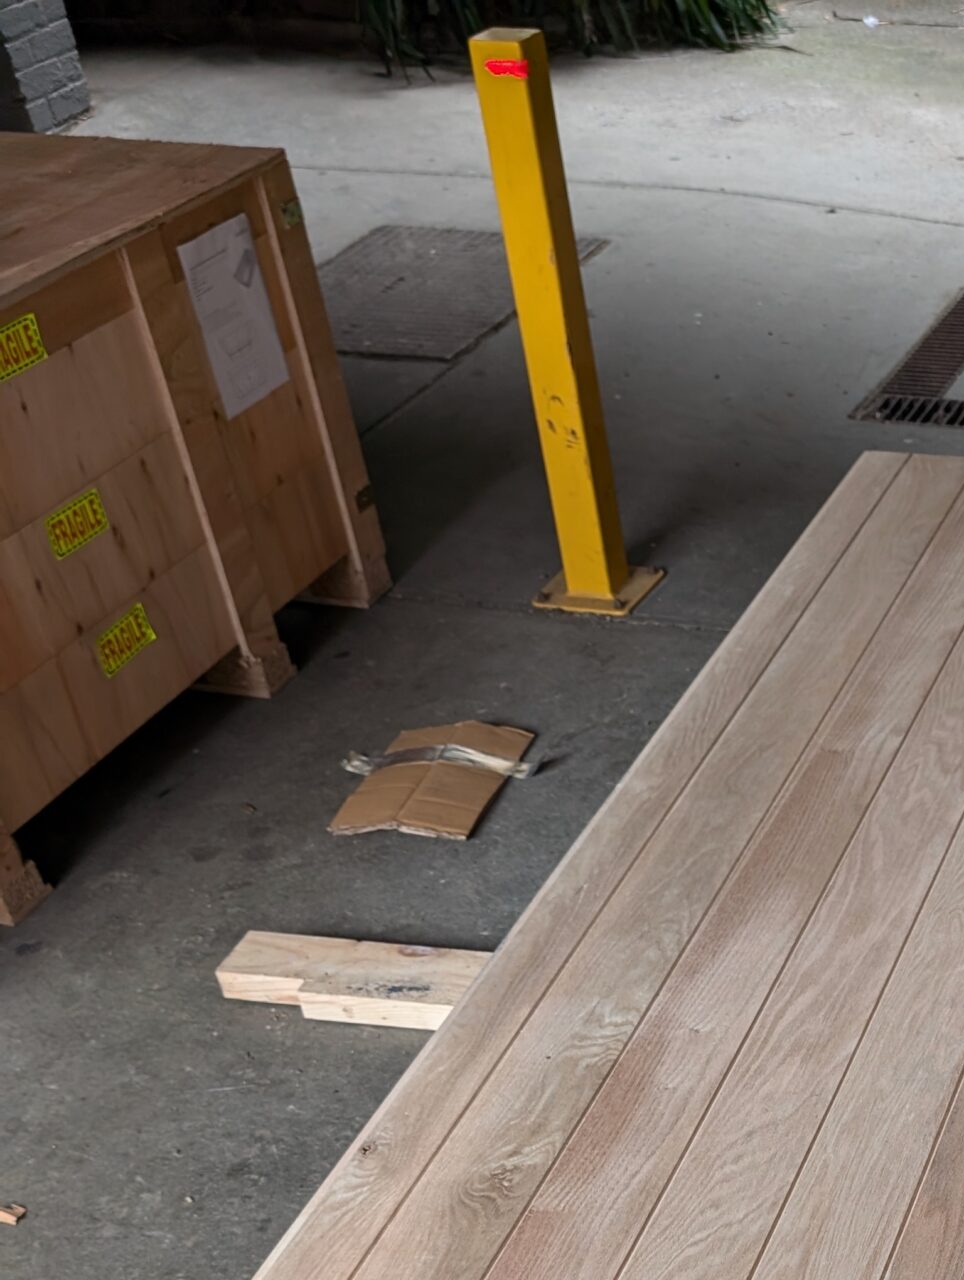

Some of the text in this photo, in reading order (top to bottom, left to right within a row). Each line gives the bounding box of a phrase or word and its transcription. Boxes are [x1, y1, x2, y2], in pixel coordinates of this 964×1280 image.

[0, 323, 38, 371] AGILE
[51, 498, 102, 551] FRAGILE
[101, 613, 147, 669] FRAGILE
